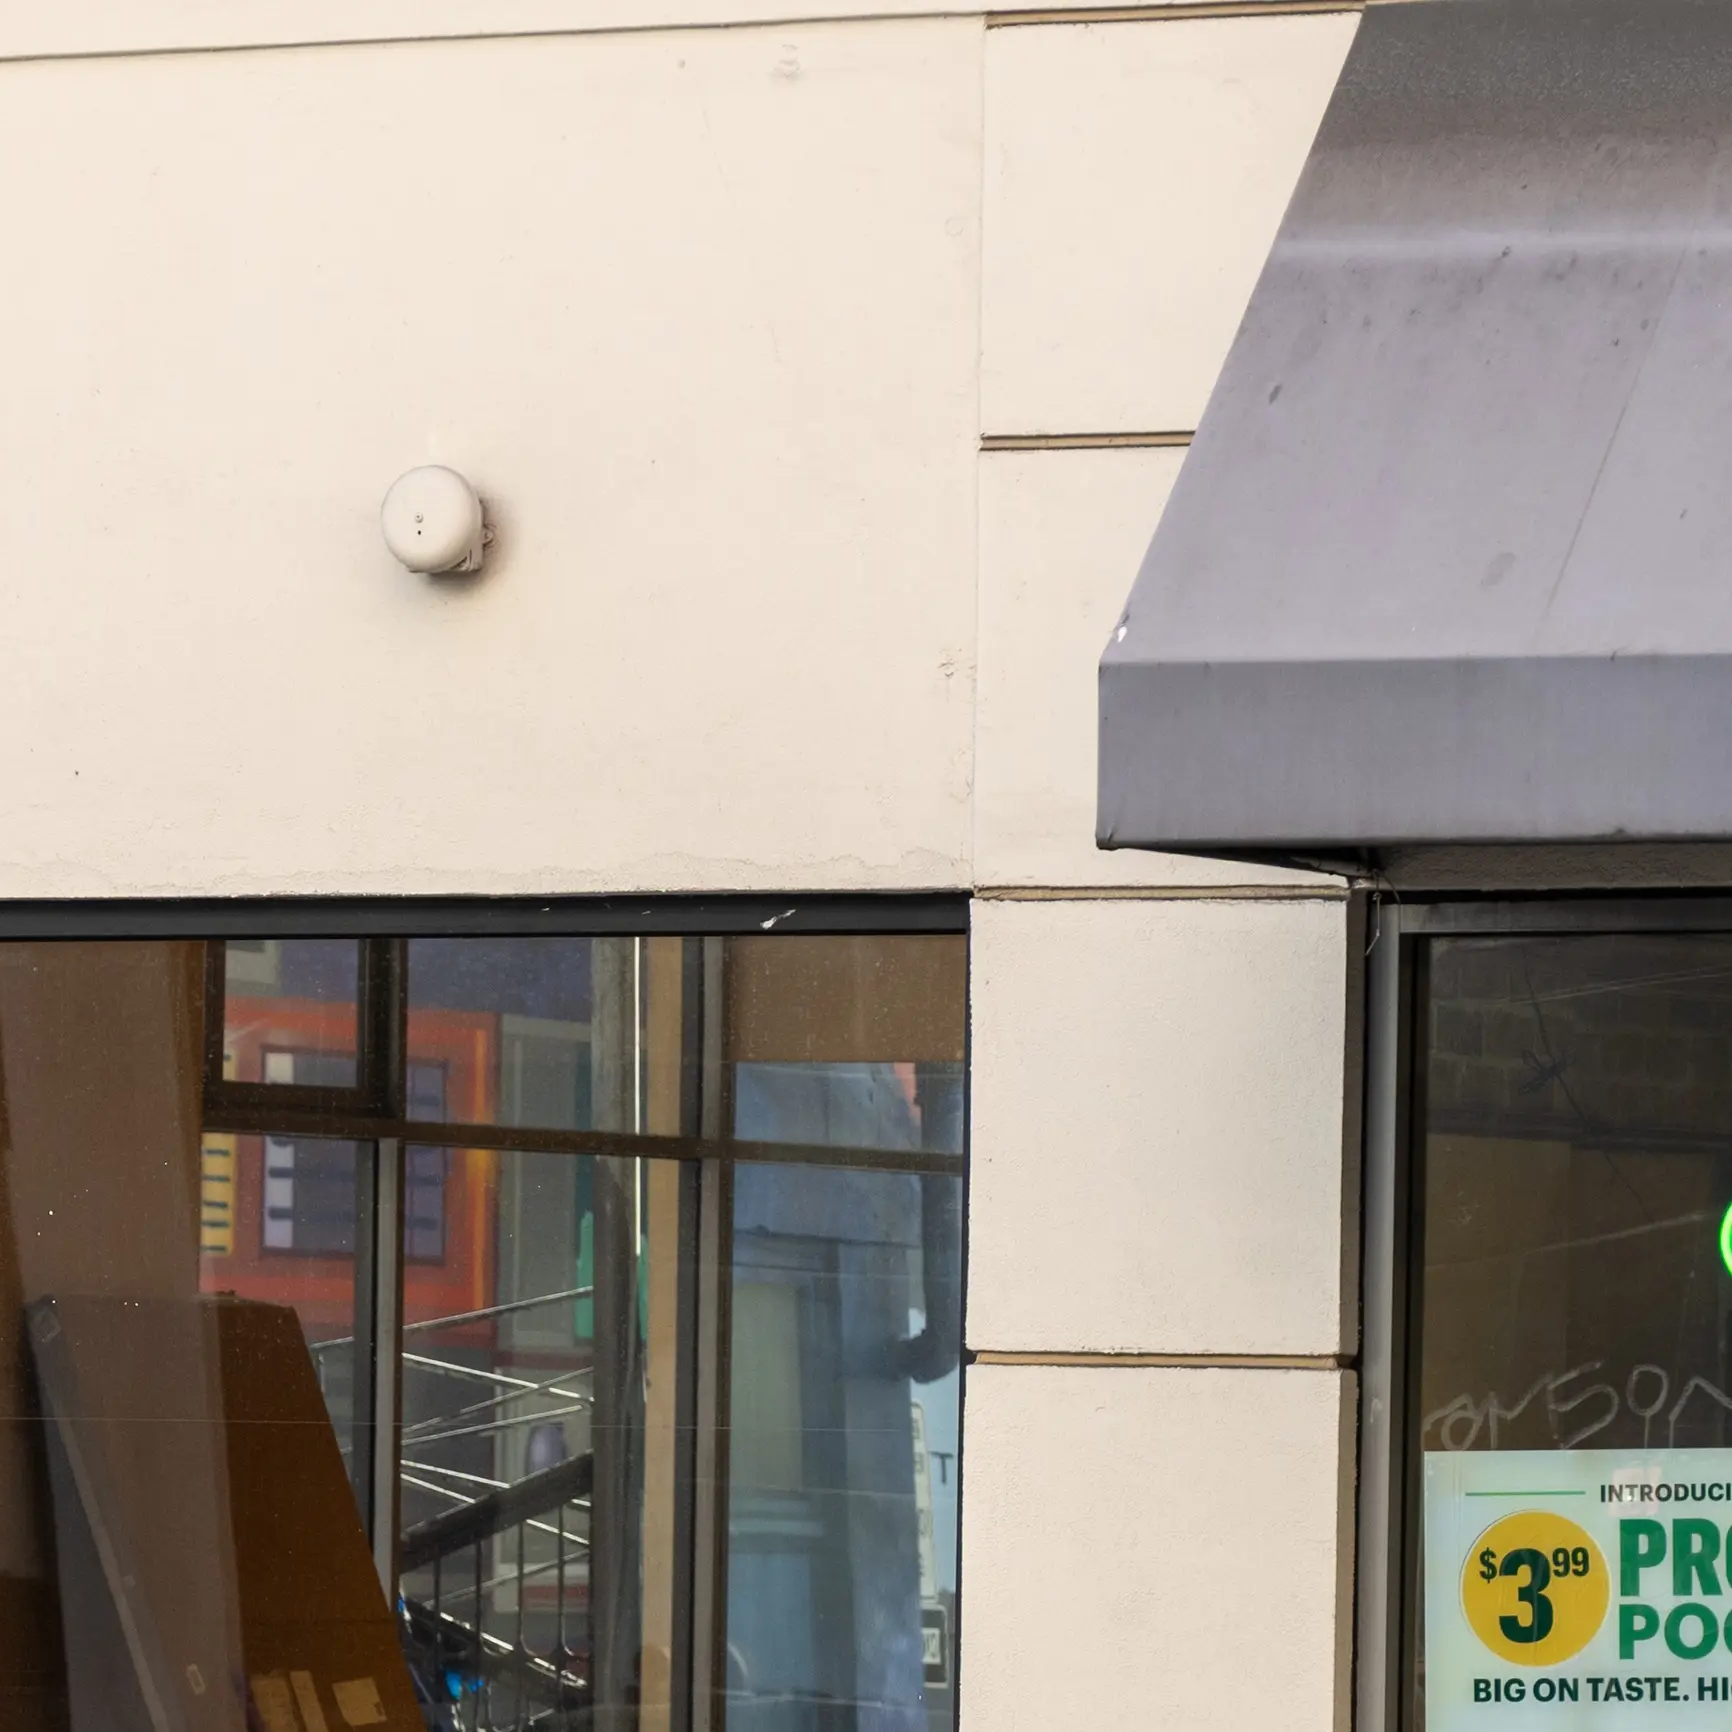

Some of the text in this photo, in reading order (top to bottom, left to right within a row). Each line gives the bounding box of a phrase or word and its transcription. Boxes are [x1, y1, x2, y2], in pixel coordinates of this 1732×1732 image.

[1620, 1518, 1732, 1597] PR
[1619, 1602, 1732, 1660] PO
[1473, 1677, 1732, 1702] BIG ON TASTE. HI
